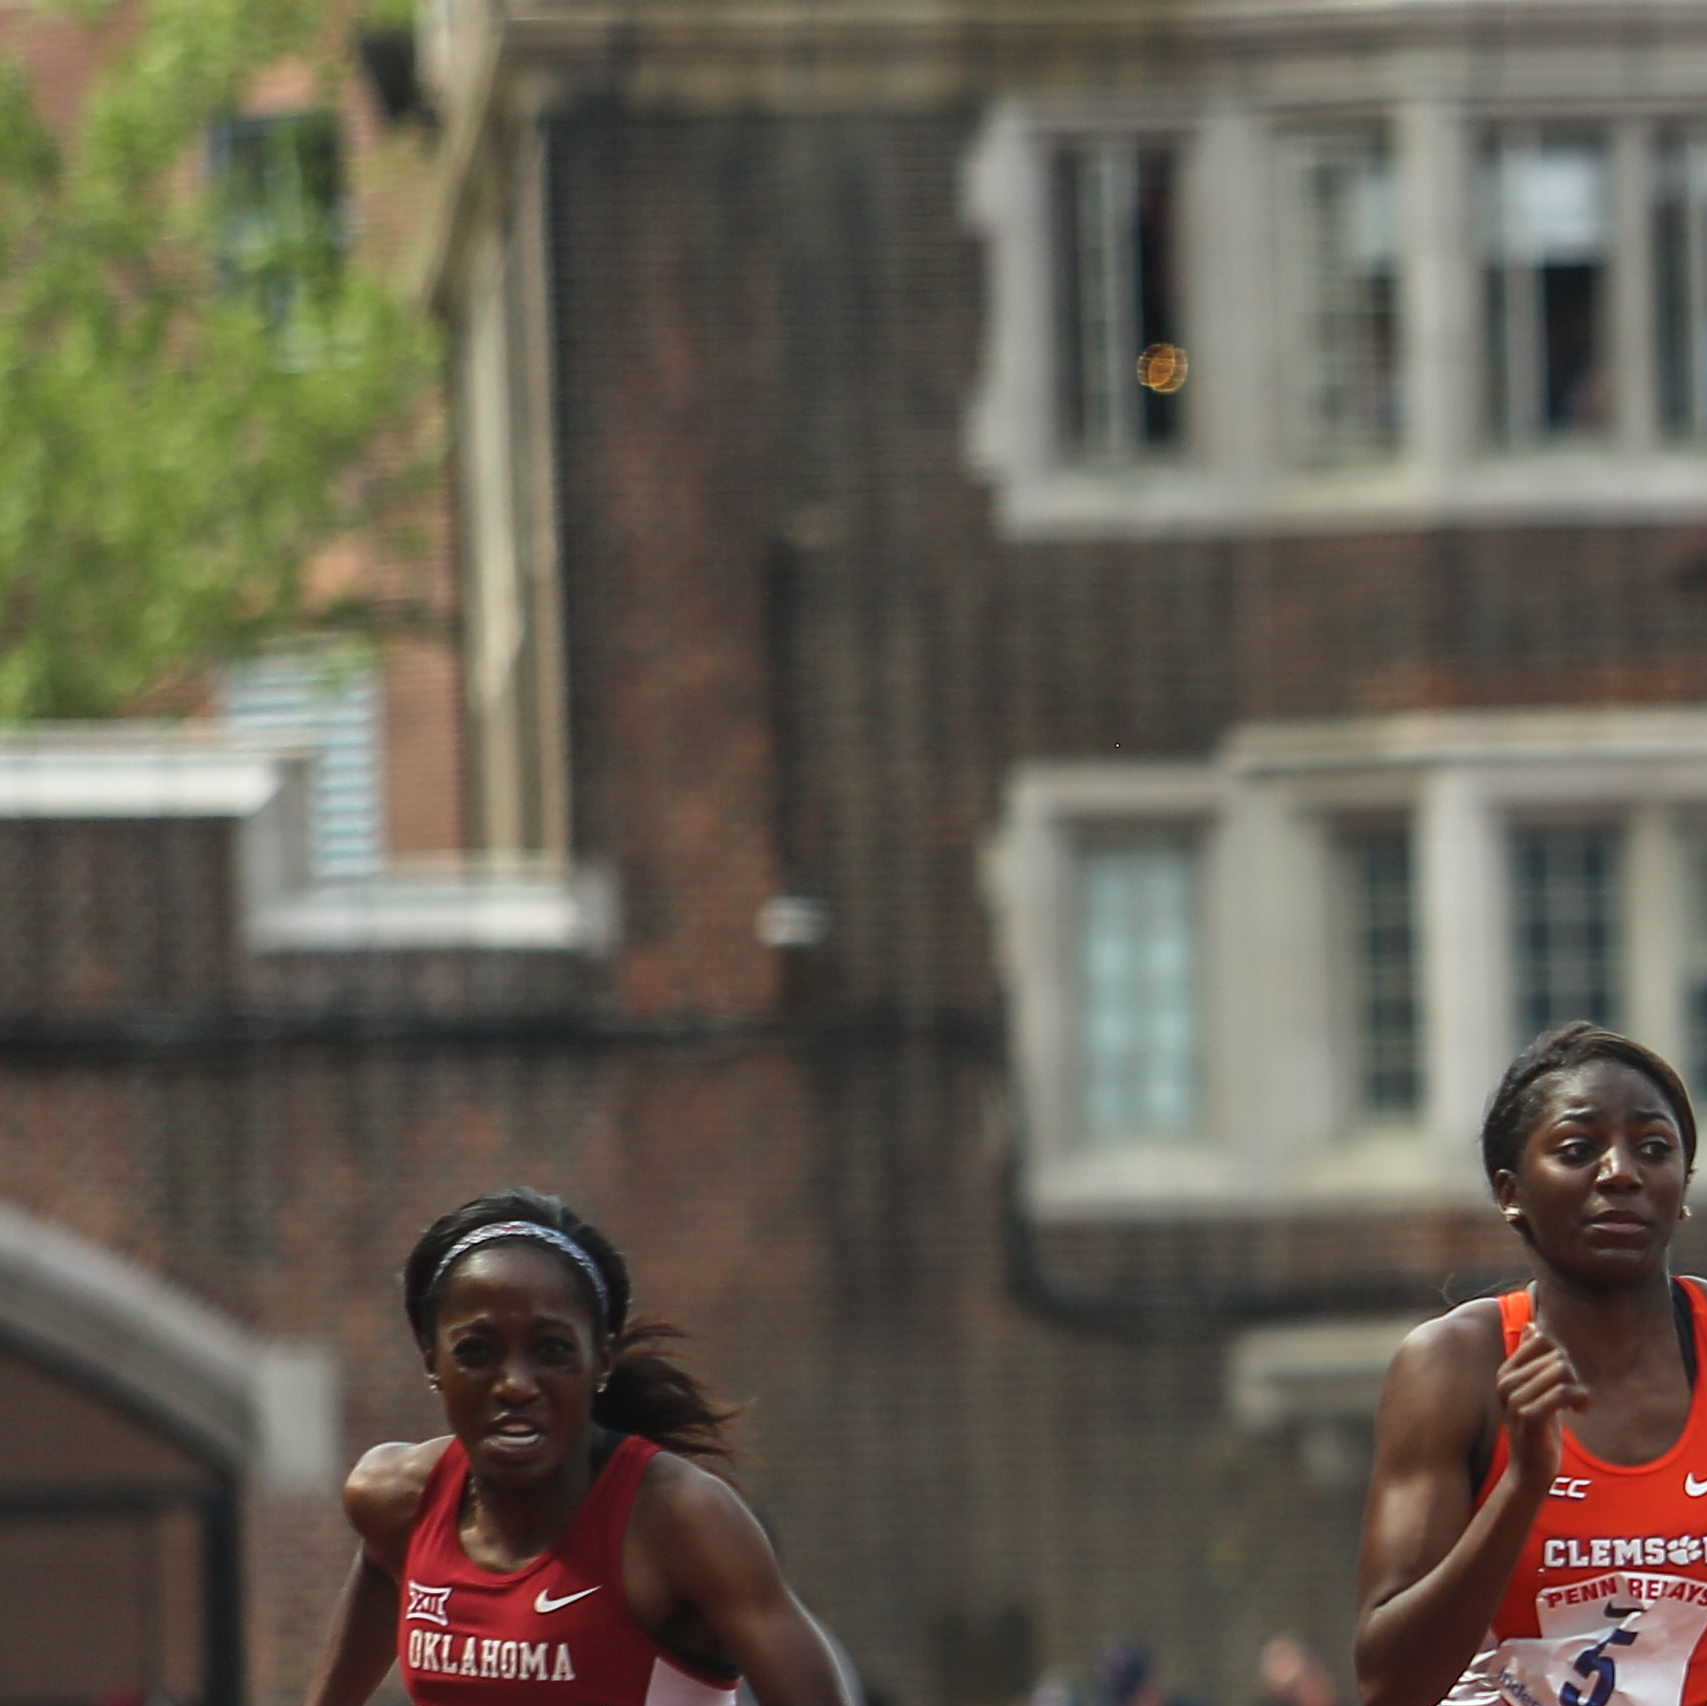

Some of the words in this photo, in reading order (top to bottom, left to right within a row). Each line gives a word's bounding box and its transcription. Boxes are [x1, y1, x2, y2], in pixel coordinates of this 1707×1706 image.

[1549, 1476, 1593, 1499] CC
[1545, 1577, 1618, 1609] PENN
[407, 1628, 576, 1682] OKLAHOMA
